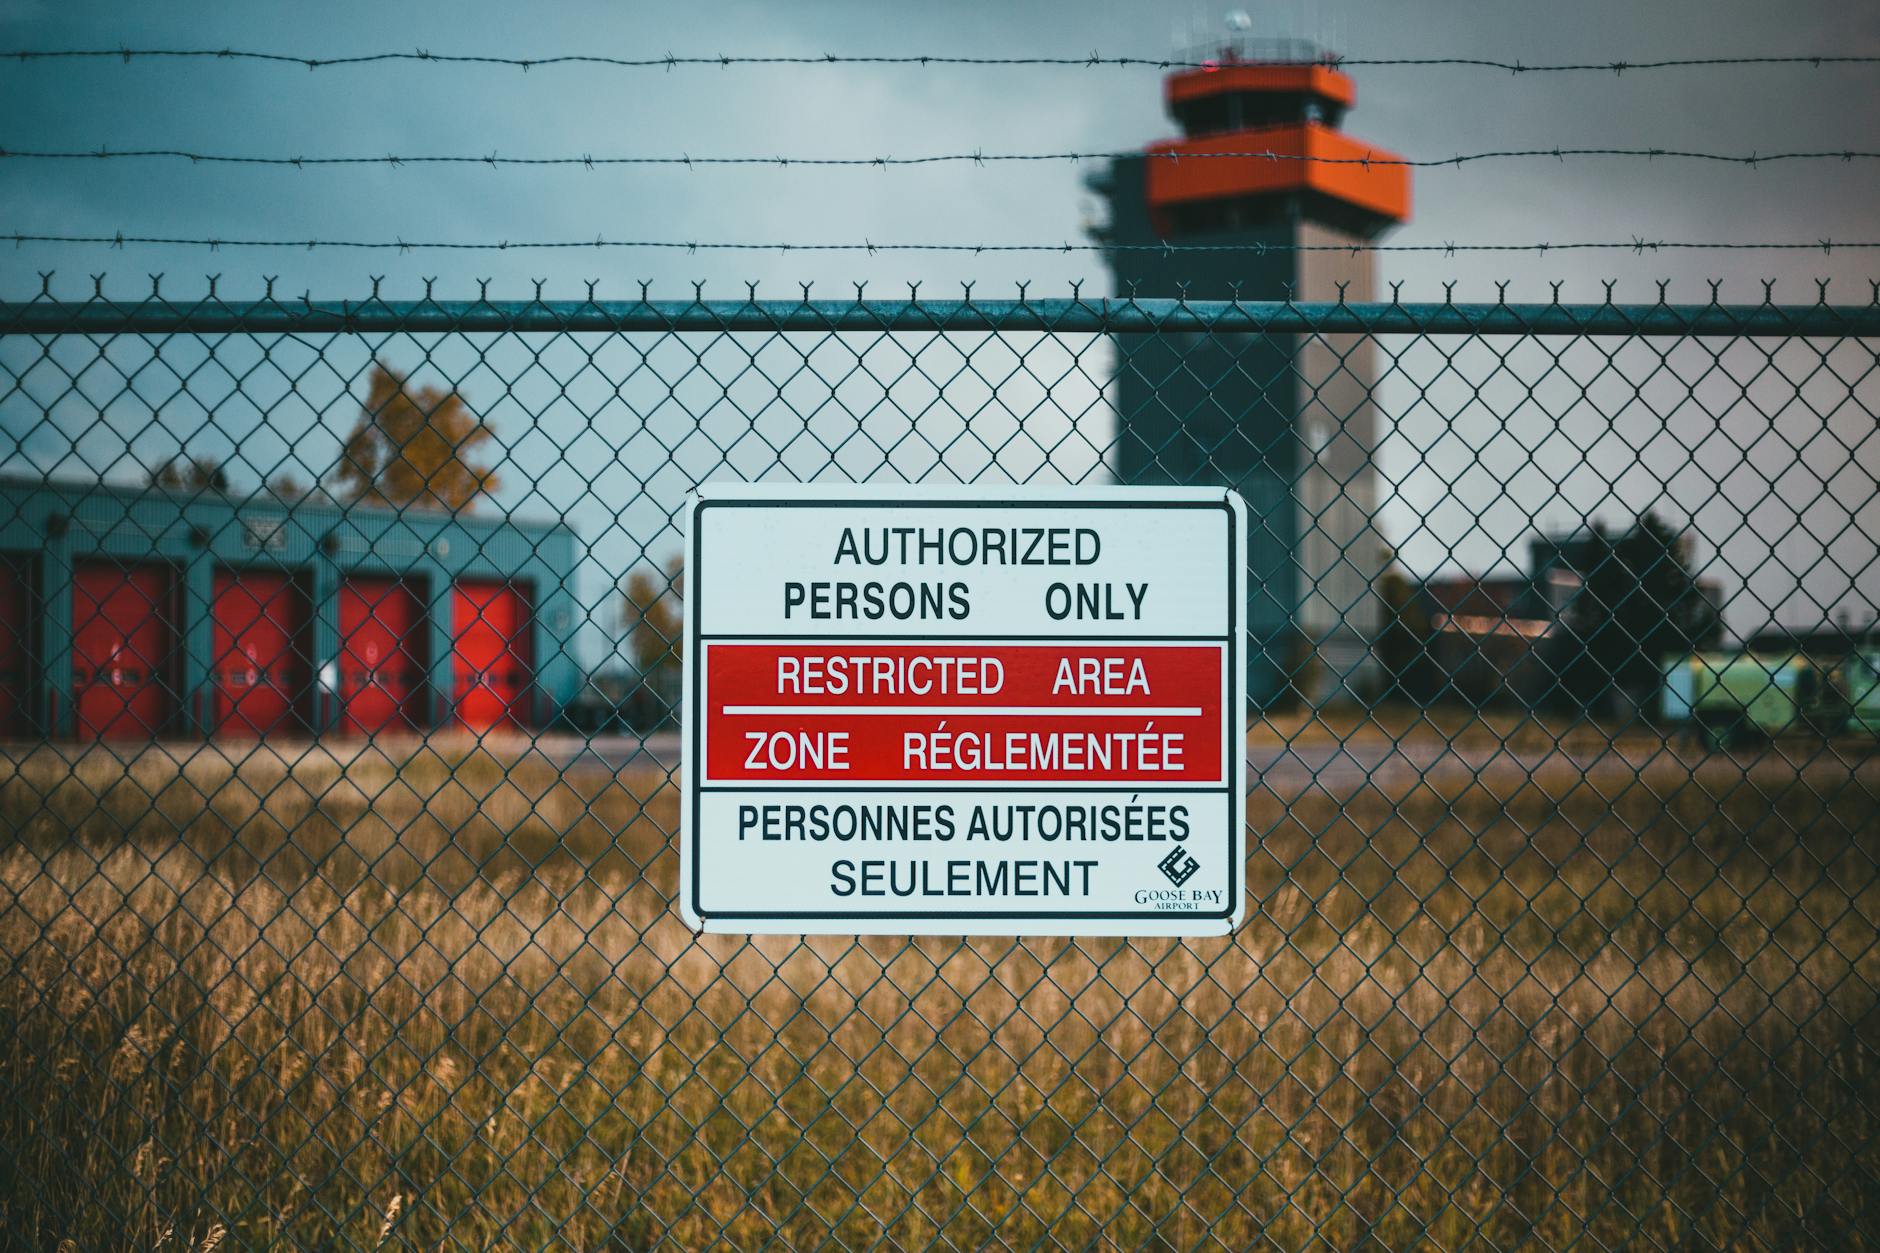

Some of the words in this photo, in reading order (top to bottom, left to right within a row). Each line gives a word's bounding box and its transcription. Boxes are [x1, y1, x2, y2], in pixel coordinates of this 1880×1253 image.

[834, 528, 1100, 565] AUTHORIZED
[785, 582, 969, 620] PERSONS
[1046, 583, 1148, 620] ONLY
[778, 656, 1004, 695] RESTRICTED
[1053, 658, 1150, 694] AREA
[745, 732, 849, 770] ZONE
[904, 721, 1184, 770] RÉGLEMENTÉE
[739, 805, 955, 841] PERSONNES
[967, 794, 1189, 841] AUTORISÉES
[831, 860, 1098, 896] SEULEMENT
[1134, 889, 1186, 905] GOOSE
[1192, 890, 1223, 904] BAY
[1154, 902, 1200, 910] AIRPORT
